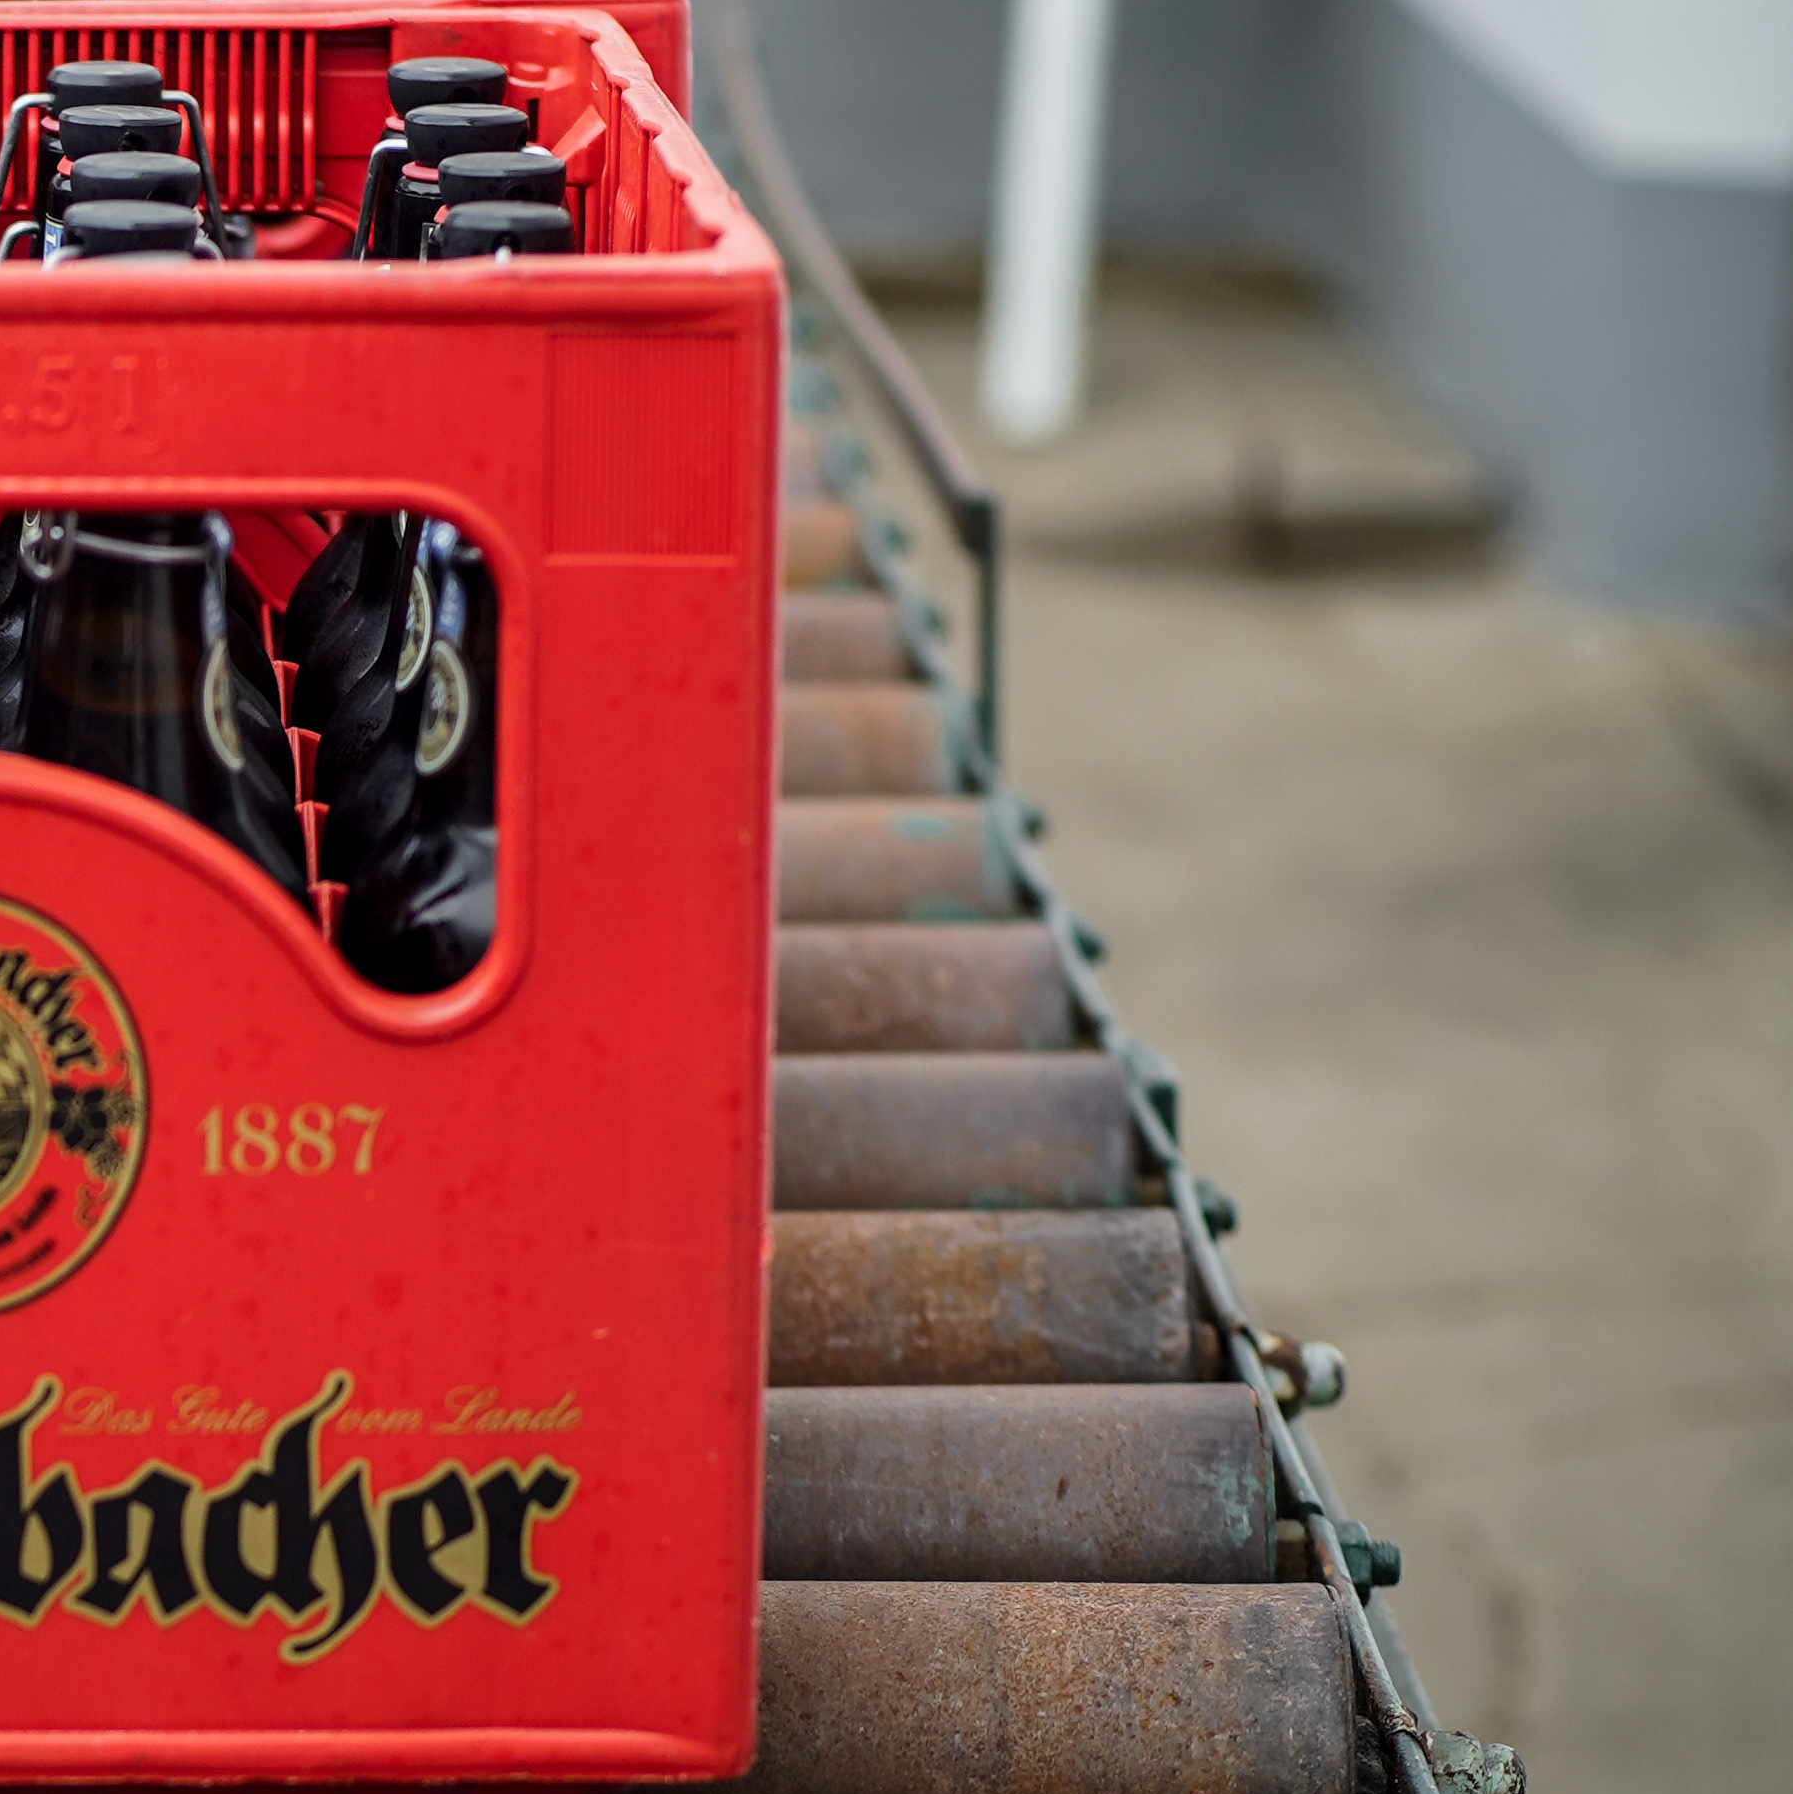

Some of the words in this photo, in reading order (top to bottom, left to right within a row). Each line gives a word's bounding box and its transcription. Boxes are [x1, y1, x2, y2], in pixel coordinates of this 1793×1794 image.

[195, 1101, 387, 1178] 1887
[58, 1385, 154, 1436] Das
[166, 1384, 269, 1436] Gute
[334, 1407, 424, 1435] vom
[429, 1384, 584, 1436] Lande
